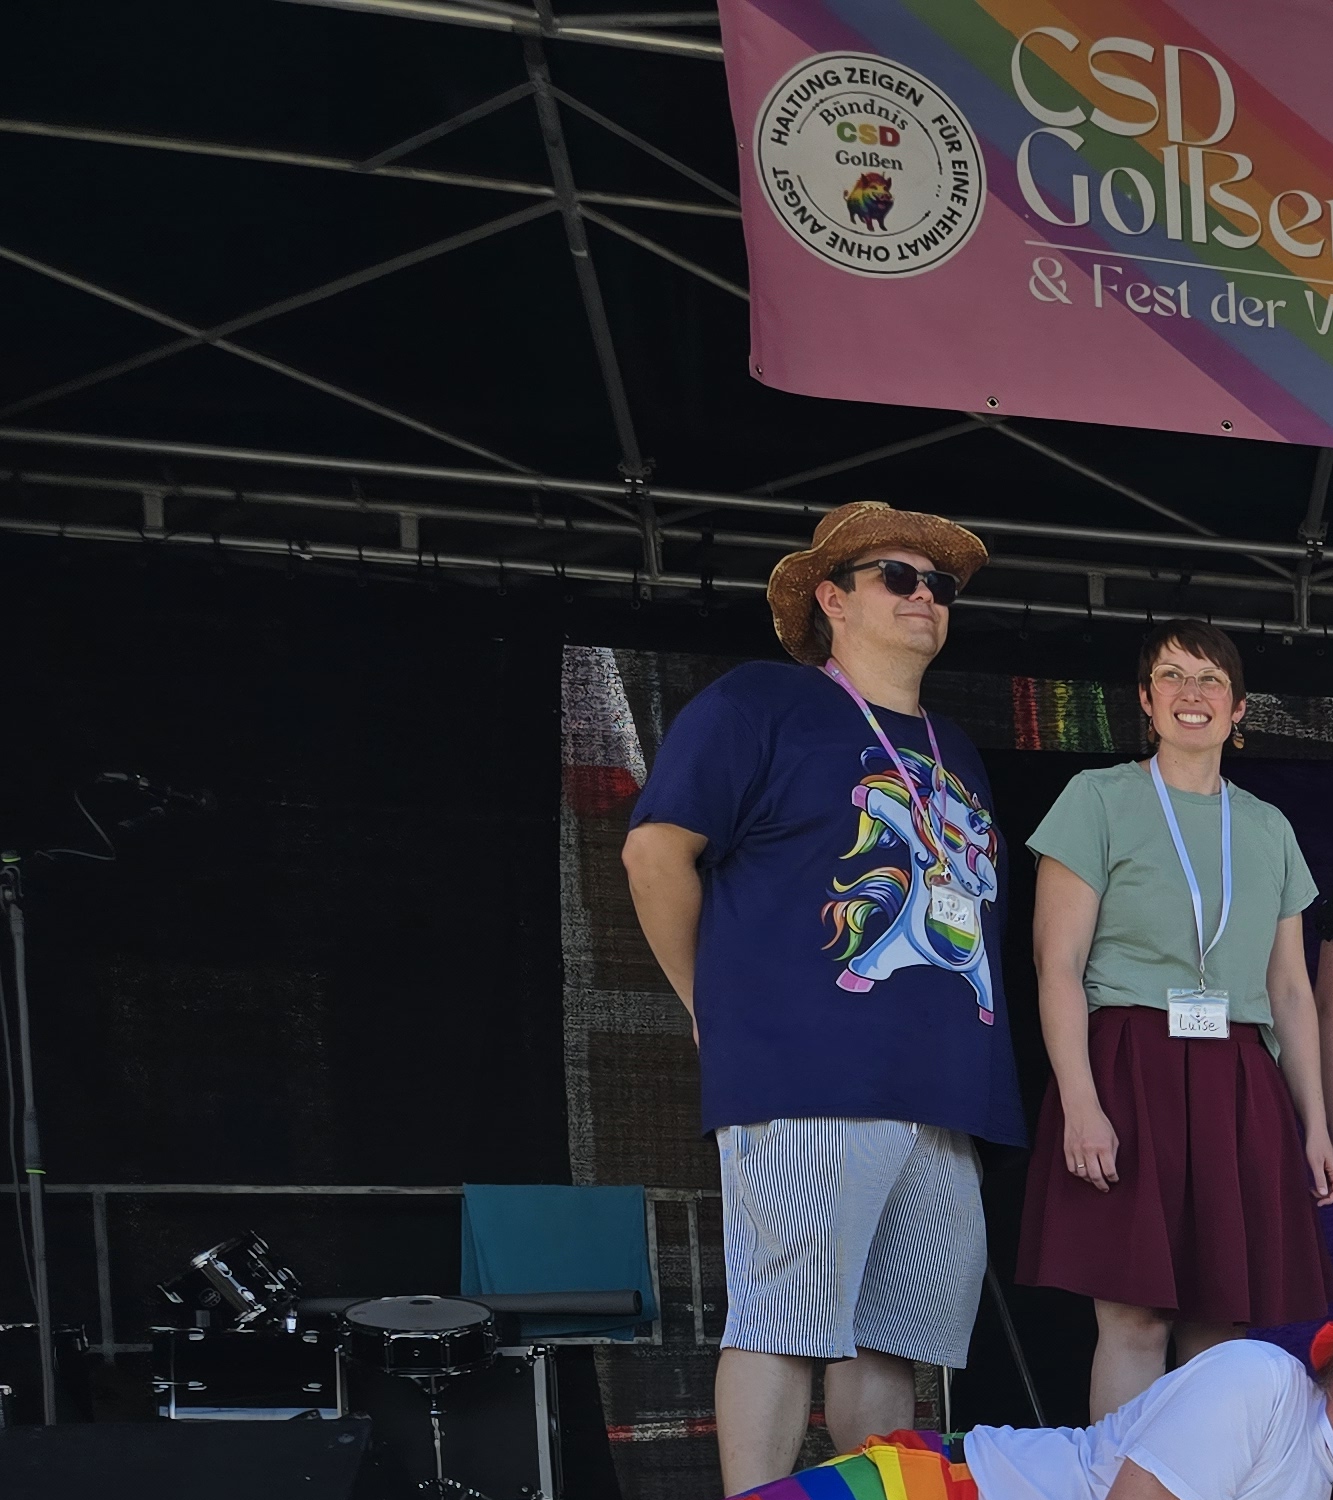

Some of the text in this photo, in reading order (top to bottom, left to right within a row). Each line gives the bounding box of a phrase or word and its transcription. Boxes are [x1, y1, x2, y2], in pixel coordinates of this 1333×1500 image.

[1011, 26, 1236, 146] CSD
[819, 99, 908, 131] Bündnis
[836, 121, 901, 147] CSD
[771, 67, 970, 262] HALTUNG ZEIGEN FÜR EINE HEIMAT OHNE ANGST
[835, 150, 903, 171] Golßen
[1029, 257, 1073, 305] &
[1092, 264, 1192, 319] Fest
[1211, 281, 1286, 328] der
[1180, 1013, 1221, 1032] Luise
